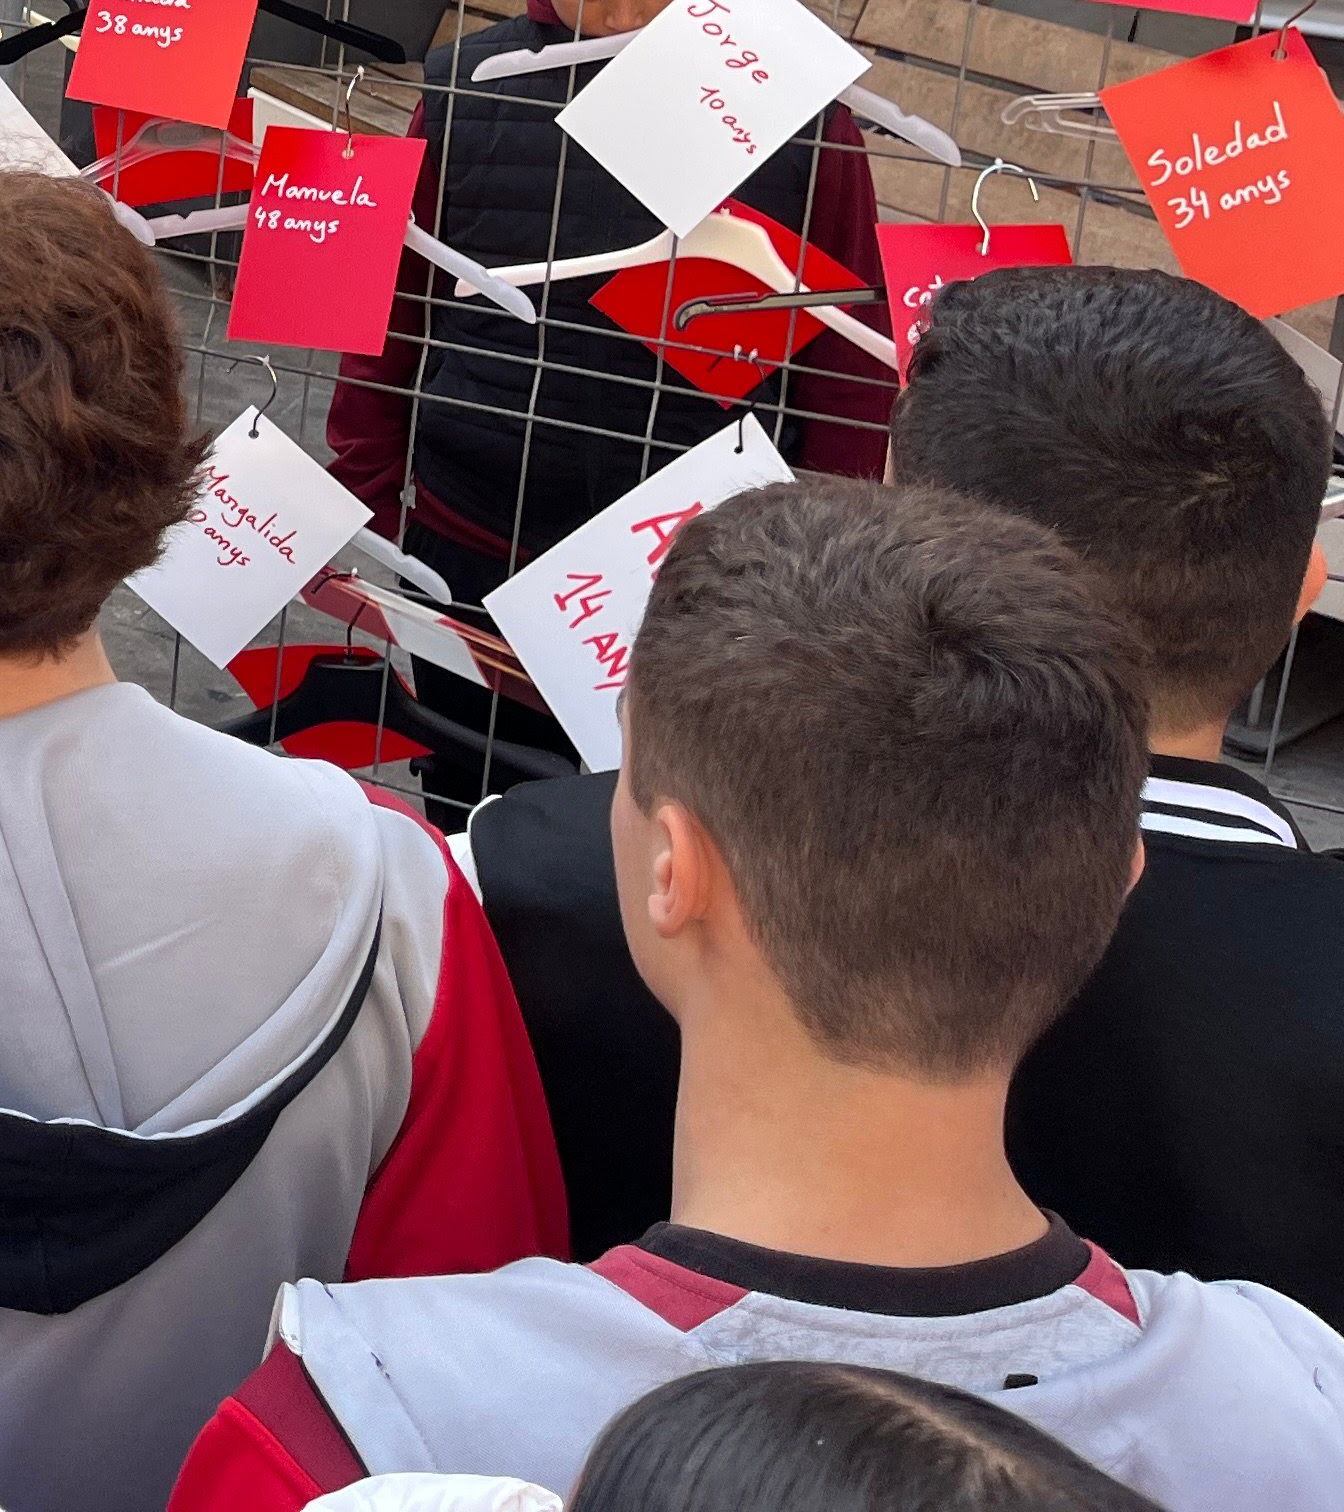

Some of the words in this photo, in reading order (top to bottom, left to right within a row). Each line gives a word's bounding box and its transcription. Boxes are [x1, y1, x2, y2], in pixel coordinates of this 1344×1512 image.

[95, 10, 129, 35] 38
[130, 23, 184, 49] anys
[698, 84, 729, 117] 10
[720, 111, 759, 158] anys
[1147, 101, 1290, 189] Soledad
[260, 173, 379, 209] Manuela
[1167, 187, 1211, 230] 34
[1218, 167, 1292, 215] anys
[254, 207, 281, 230] 48
[281, 215, 341, 244] anys
[203, 527, 251, 566] anys
[553, 572, 613, 630] 14
